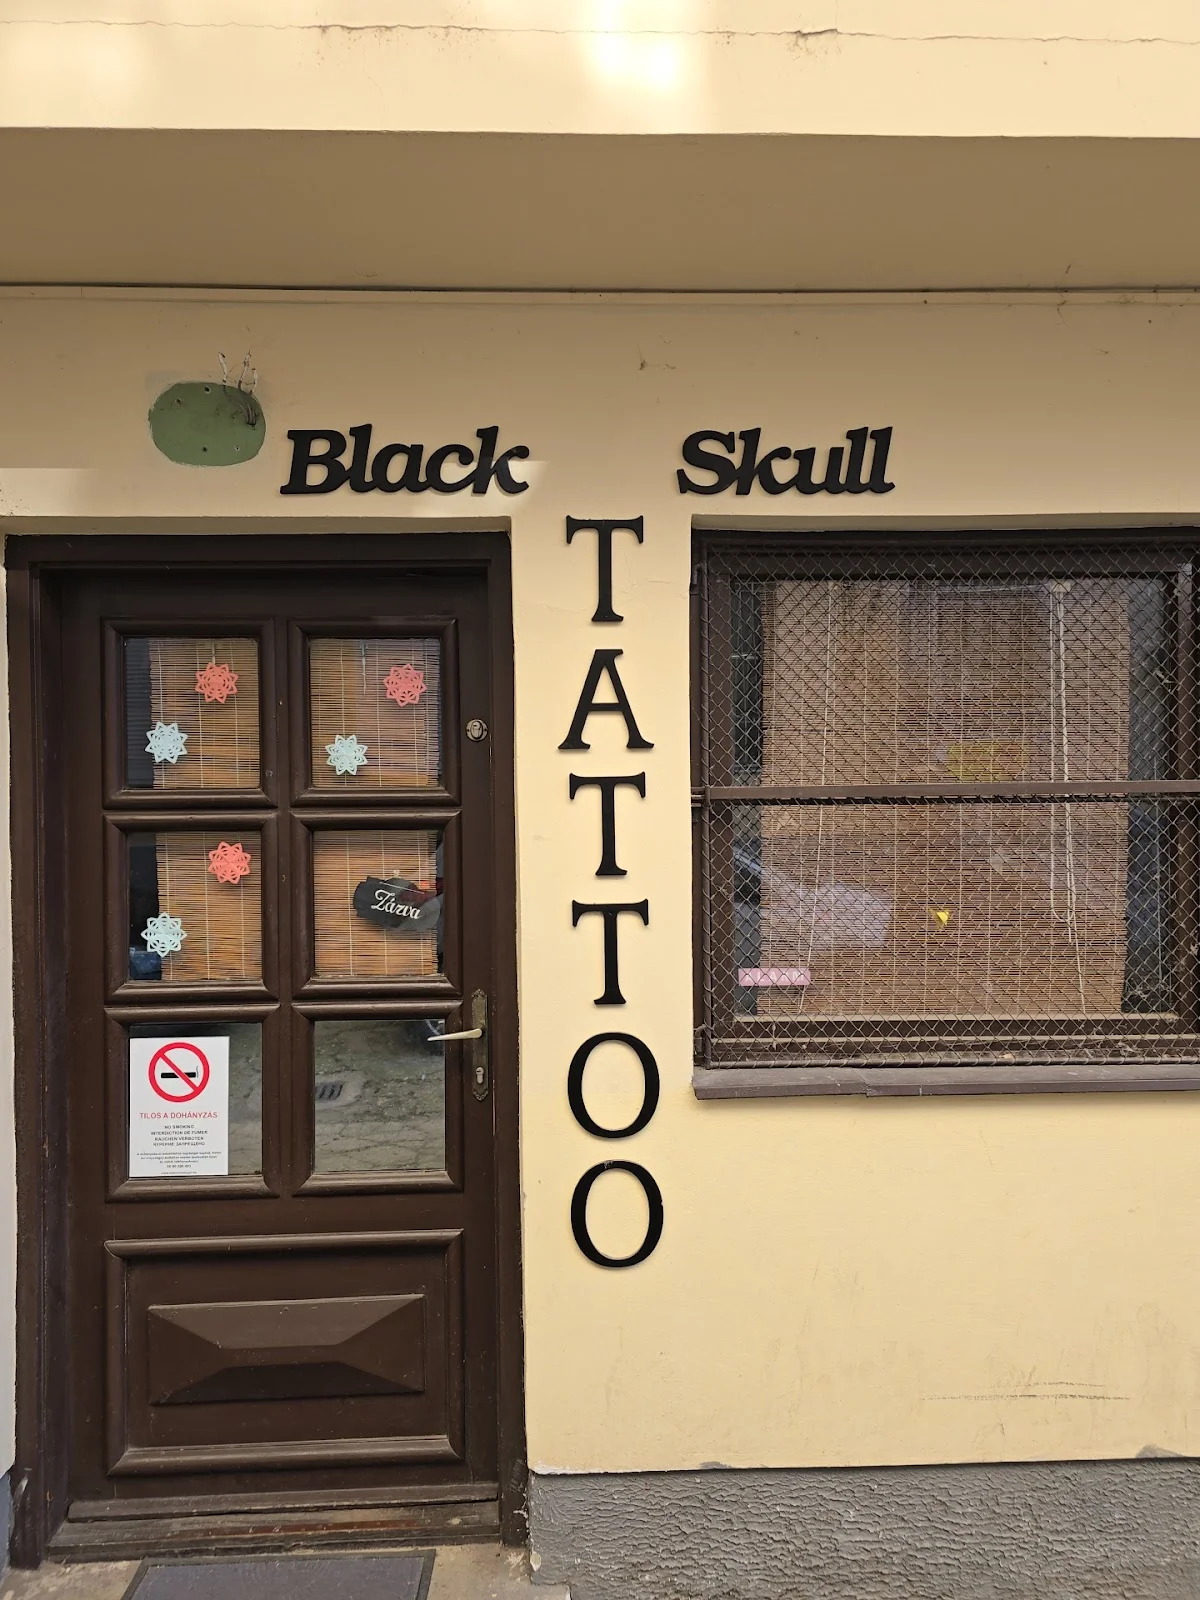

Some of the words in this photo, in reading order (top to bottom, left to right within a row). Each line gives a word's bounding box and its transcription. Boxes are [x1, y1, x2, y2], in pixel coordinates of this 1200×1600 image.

[280, 424, 529, 495] Black
[677, 427, 895, 496] Skull
[370, 889, 421, 920] Zárva
[557, 515, 664, 1268] TATTOO
[170, 1111, 218, 1119] DOHÁNYZÁS
